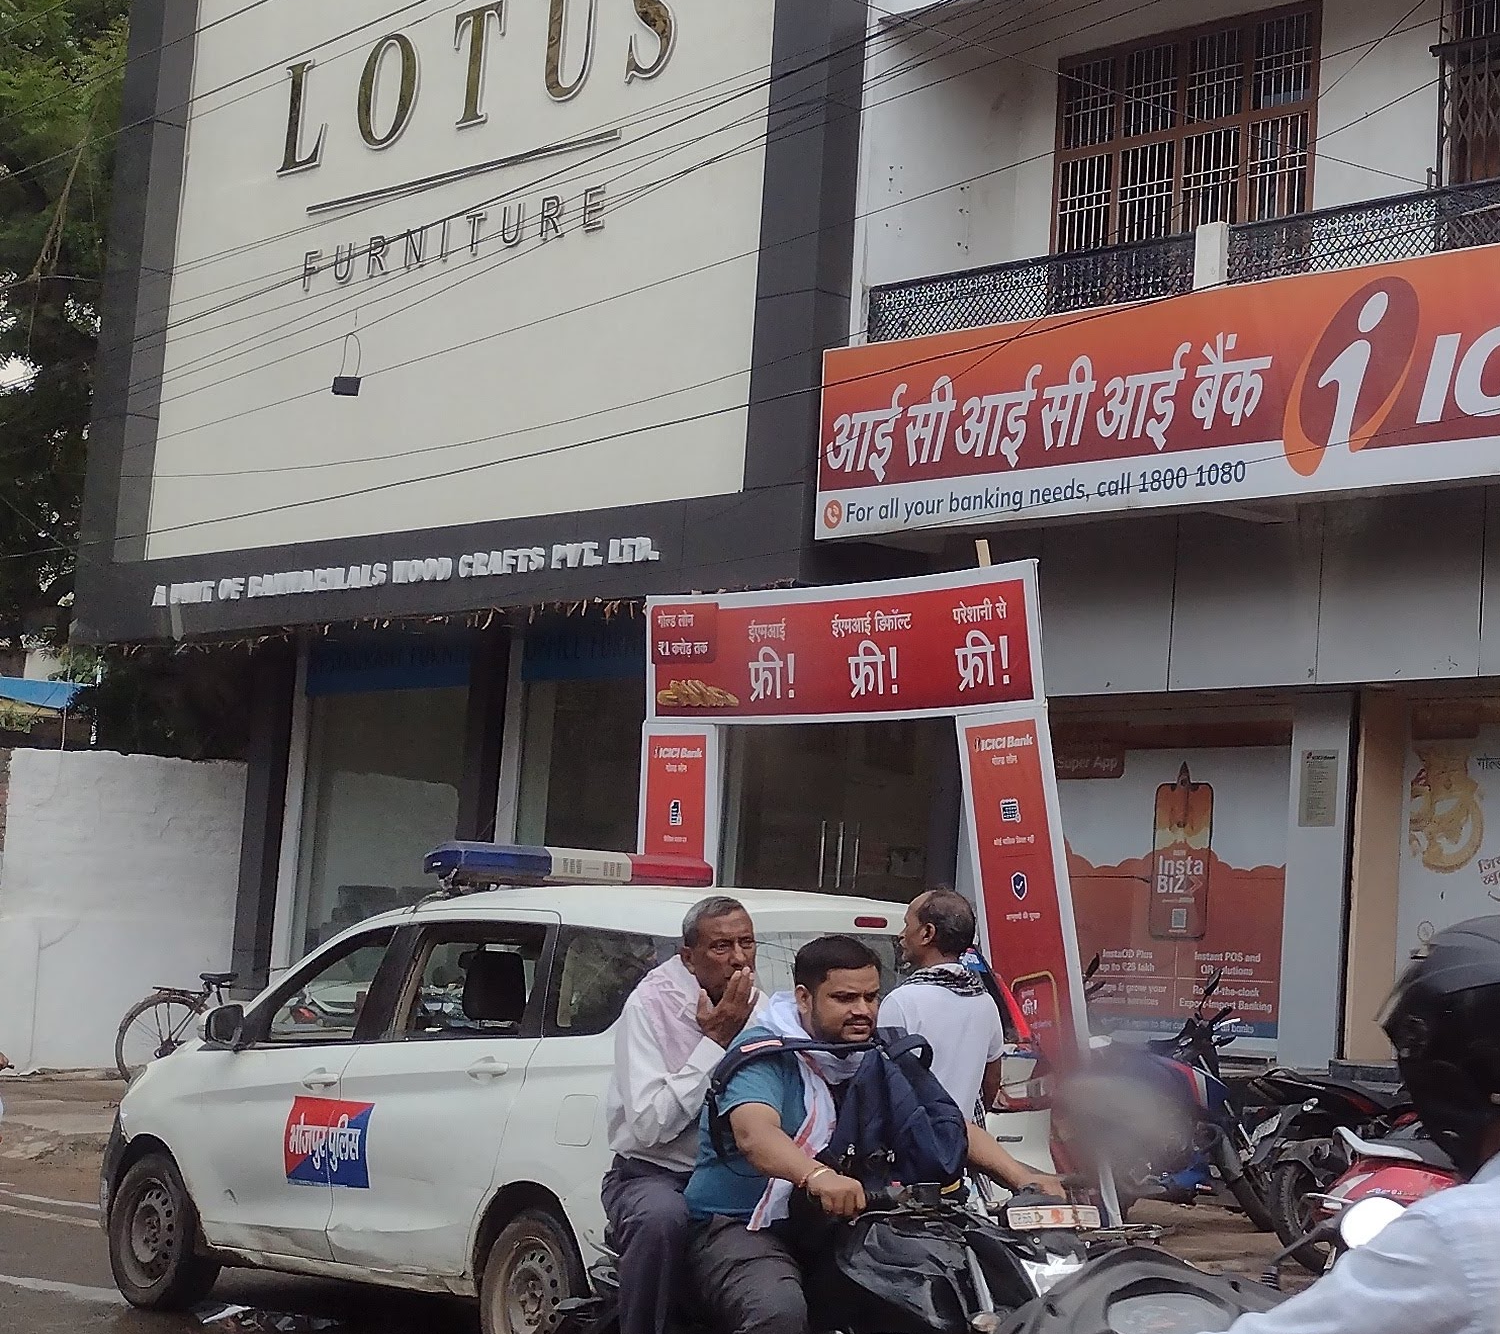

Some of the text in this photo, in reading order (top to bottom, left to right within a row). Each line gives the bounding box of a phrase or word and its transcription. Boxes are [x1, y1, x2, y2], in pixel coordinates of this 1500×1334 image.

[302, 185, 606, 291] FURNITURE
[825, 332, 1273, 482] आई सी आई सी आई बैंक
[846, 459, 1246, 524] For all your banking needs, call 1800 1080
[218, 577, 245, 599] OF
[393, 557, 452, 583] WOOD
[458, 547, 545, 578] CRAFTS
[608, 536, 660, 564] LTD.
[657, 610, 694, 628] गोल्ड लोन
[831, 611, 871, 638] ईएमआई
[952, 596, 1008, 626] परेशानी से
[748, 618, 786, 643] ईएमआई
[658, 641, 670, 656] ₹1
[671, 637, 692, 658] करोड़
[693, 641, 709, 655] तक
[955, 629, 1011, 692] फ्री!
[749, 646, 796, 702] फ्री!
[849, 640, 899, 699] फ्री!
[981, 733, 1034, 752] ICICI Bank
[1093, 756, 1119, 772] App
[1158, 855, 1204, 875] Insta
[1135, 949, 1153, 959] Plus
[1194, 951, 1261, 963] Instant POS and
[1238, 1000, 1272, 1013] Banking
[288, 1113, 361, 1172] भोजपुर पुलिस
